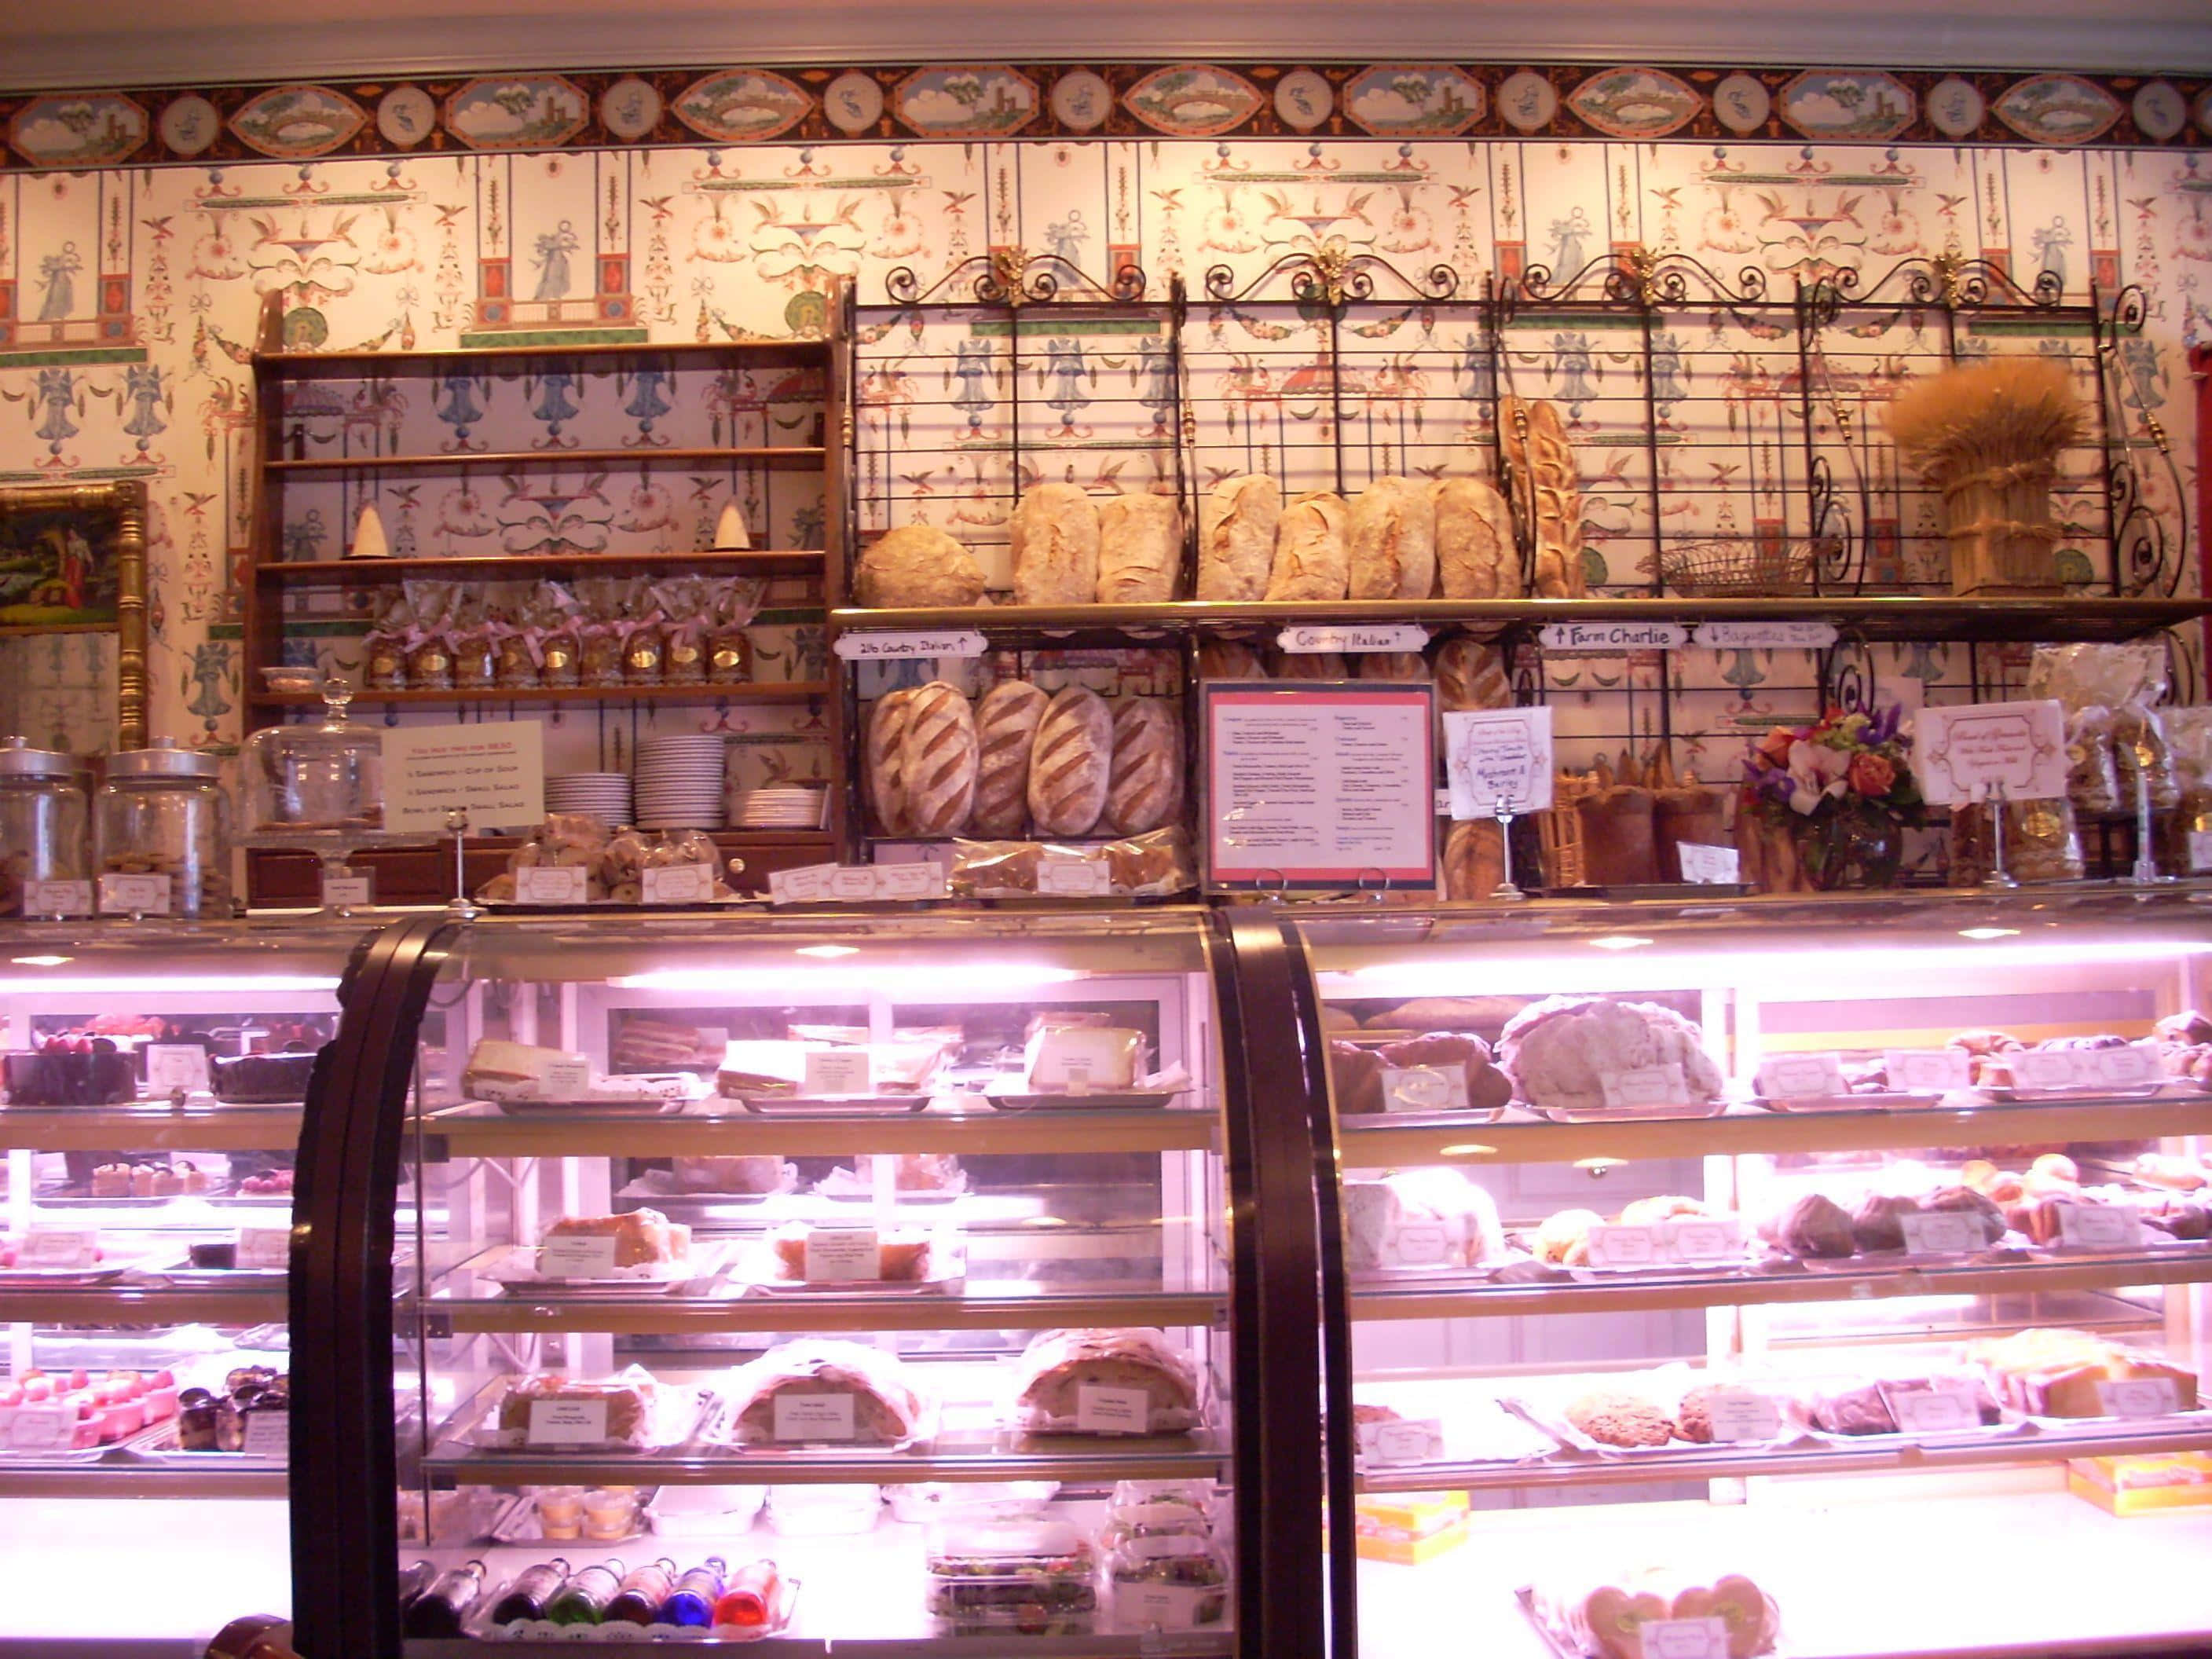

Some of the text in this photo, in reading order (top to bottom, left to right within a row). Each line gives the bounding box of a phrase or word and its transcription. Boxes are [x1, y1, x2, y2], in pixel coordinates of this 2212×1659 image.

[1295, 630, 1390, 652] Country Italian
[1569, 626, 1671, 645] Farm Charlie
